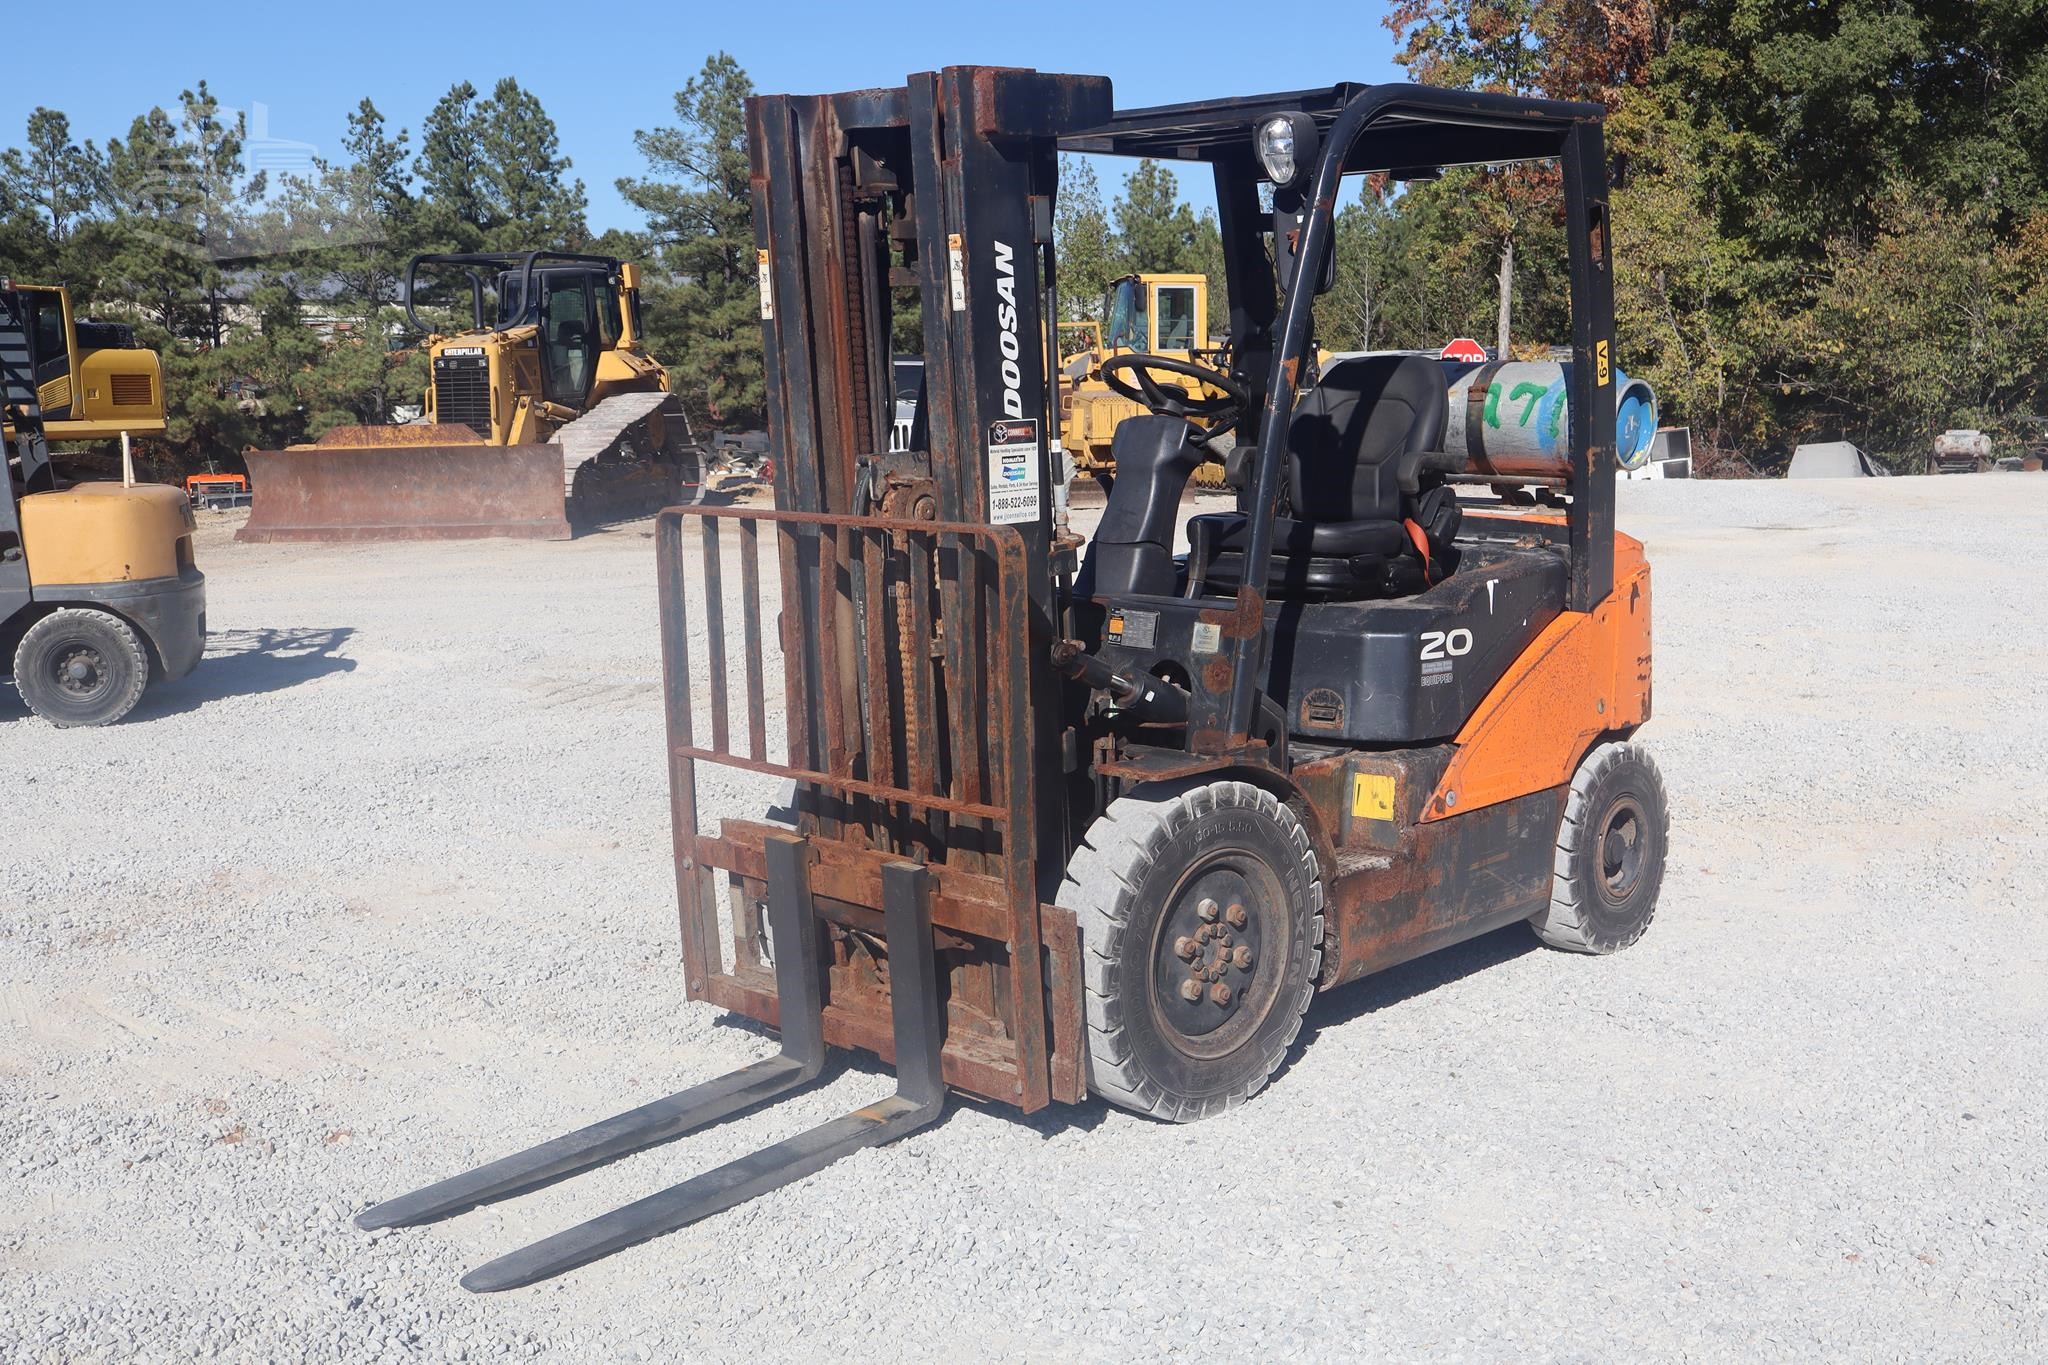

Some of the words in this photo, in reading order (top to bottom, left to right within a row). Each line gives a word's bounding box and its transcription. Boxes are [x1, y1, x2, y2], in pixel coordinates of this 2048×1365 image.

[994, 240, 1023, 419] DOOSAN
[444, 347, 483, 356] CATERPILLAR
[1599, 345, 1608, 378] V-9
[1002, 456, 1025, 464] KOMATSU
[992, 495, 1037, 510] 1-888-522-6099
[1420, 628, 1473, 660] 20
[1421, 672, 1454, 687] EQUIPPED
[1285, 867, 1305, 986] NEXEN
